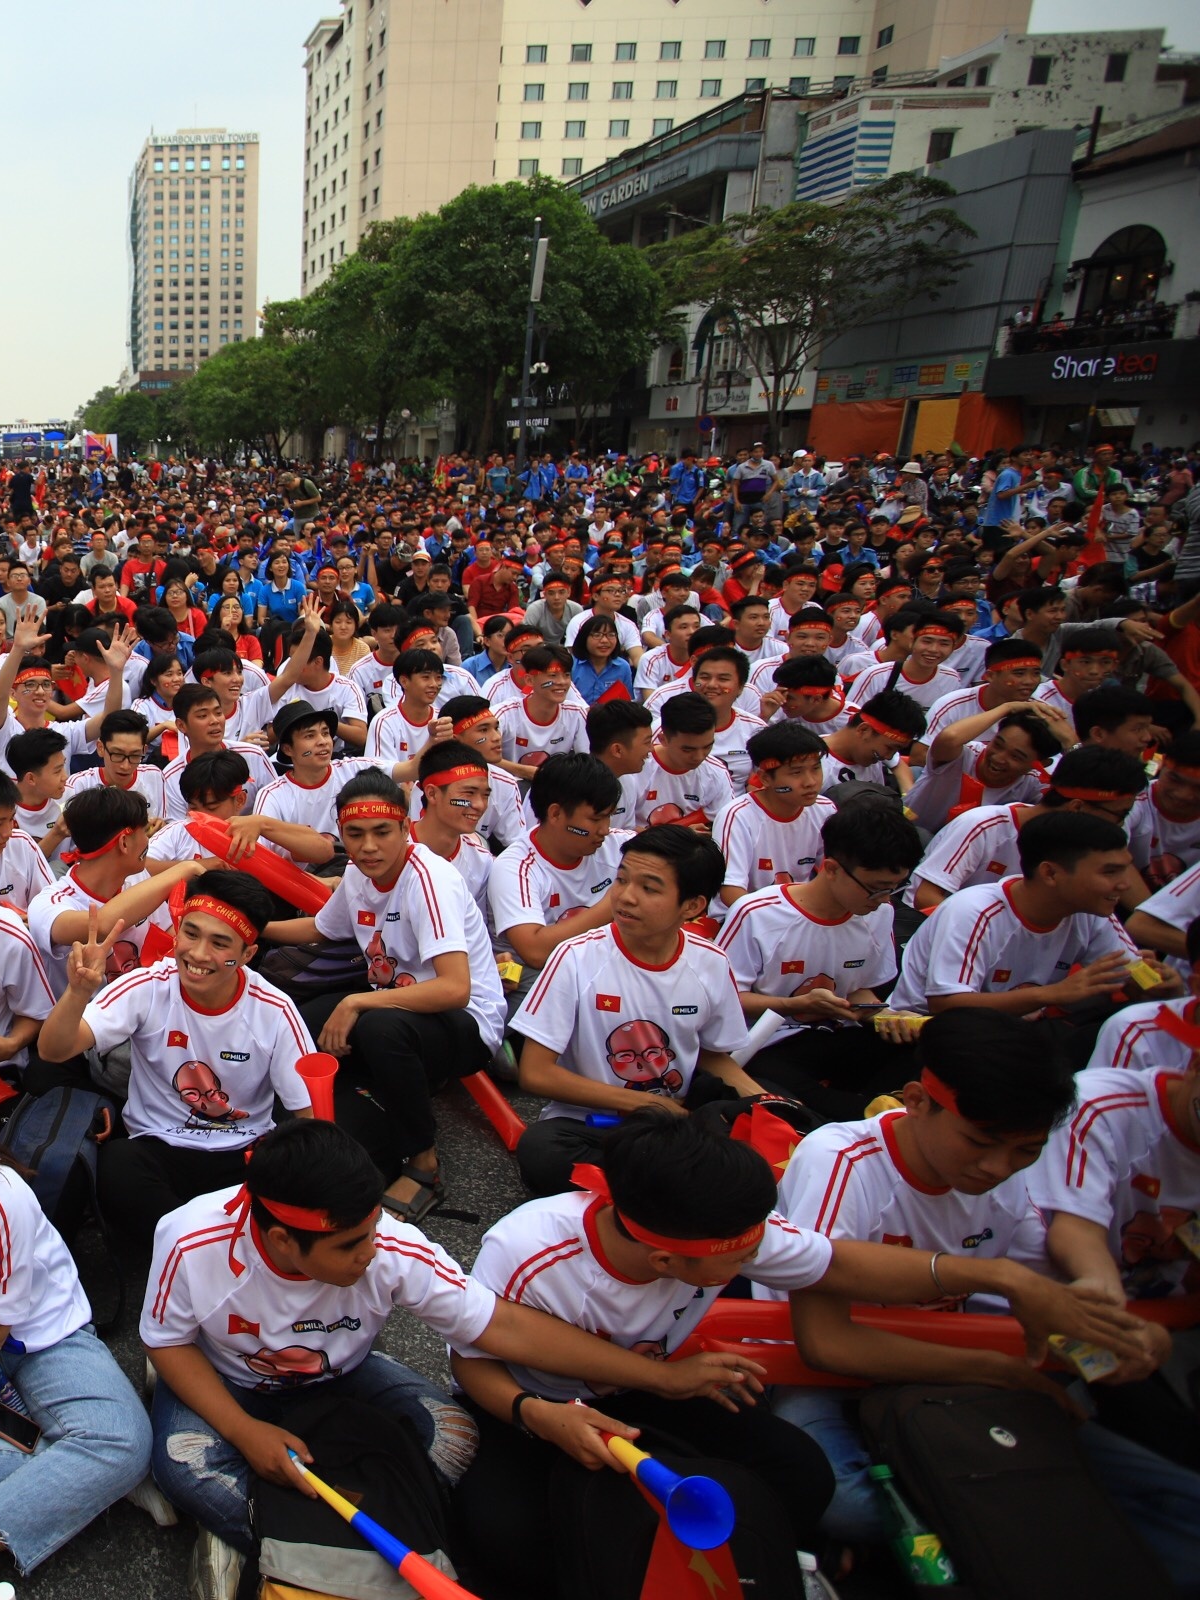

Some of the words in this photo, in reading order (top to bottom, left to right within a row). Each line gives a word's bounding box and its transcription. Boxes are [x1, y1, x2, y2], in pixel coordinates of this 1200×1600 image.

[160, 135, 201, 144] HARBOUR
[204, 134, 225, 143] VIEW
[228, 133, 258, 141] TOWER
[600, 173, 649, 210] GARDEN
[1052, 352, 1158, 379] Sharetea
[455, 767, 469, 776] VIỆT
[346, 806, 358, 816] NAM
[371, 803, 390, 813] CHIẾN
[567, 825, 588, 835] VPMILK
[591, 879, 611, 893] VPMILK
[191, 898, 205, 908] NAM
[215, 905, 238, 922] CHIẾN
[238, 919, 253, 938] THẮNG
[387, 913, 400, 921] MILK
[221, 1052, 247, 1061] VPMILK
[710, 1236, 737, 1253] VIỆT
[739, 1224, 761, 1246] NAM
[293, 1323, 323, 1332] VPMILK
[328, 1318, 358, 1331] VPMILK
